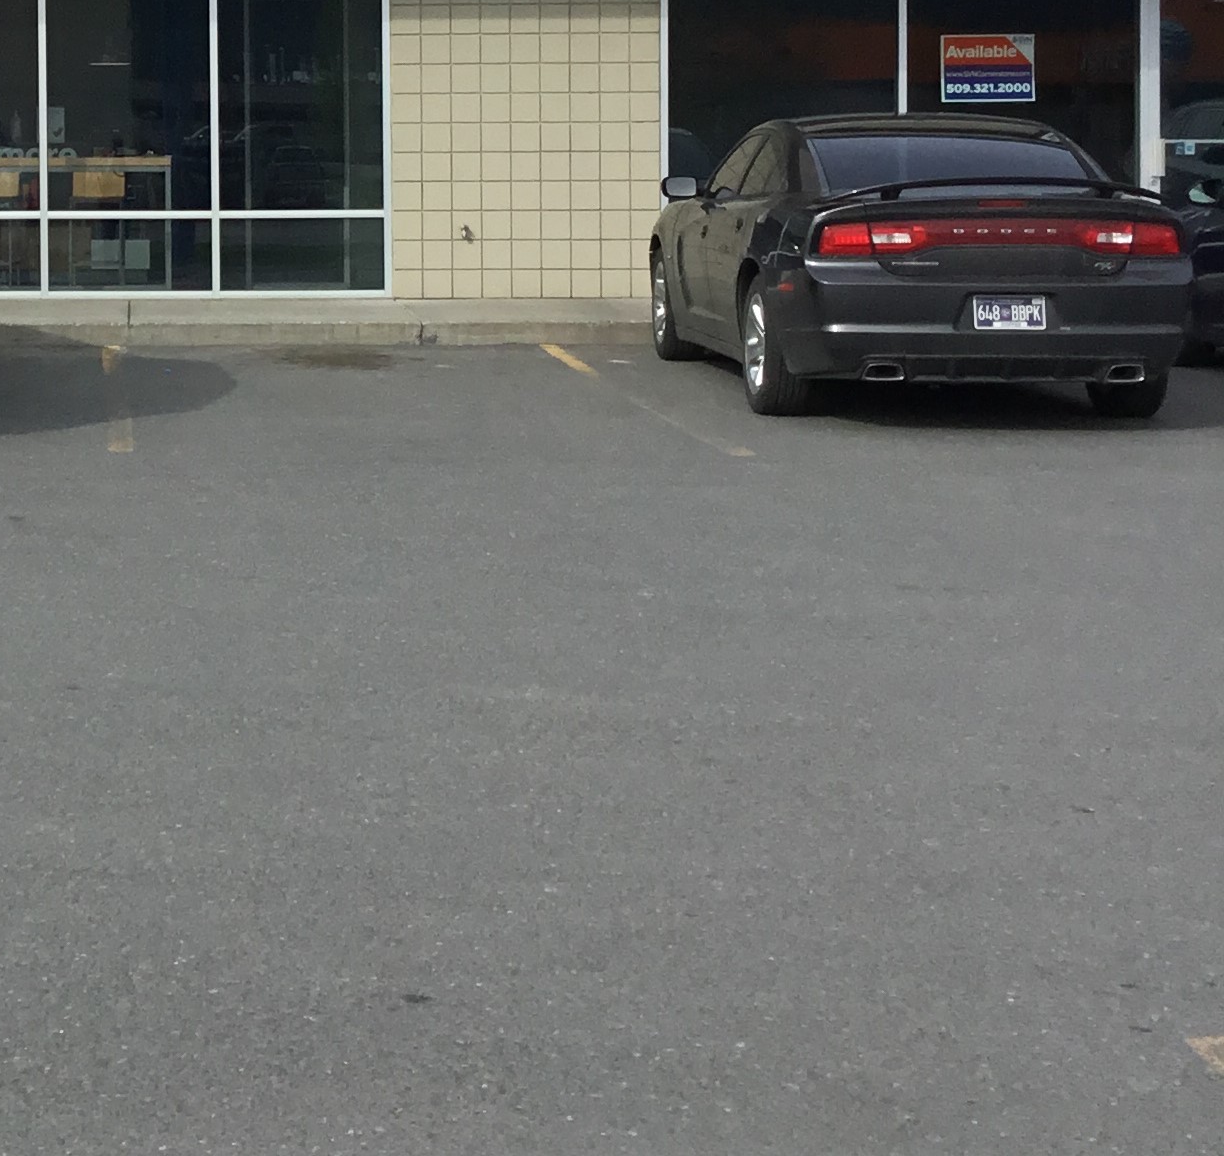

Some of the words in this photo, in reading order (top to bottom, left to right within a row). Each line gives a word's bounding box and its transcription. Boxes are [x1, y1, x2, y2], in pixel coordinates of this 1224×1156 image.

[945, 45, 1017, 58] Available
[946, 83, 1031, 93] 509.321.2000
[978, 305, 1001, 321] 648
[1011, 305, 1041, 321] BBPK
